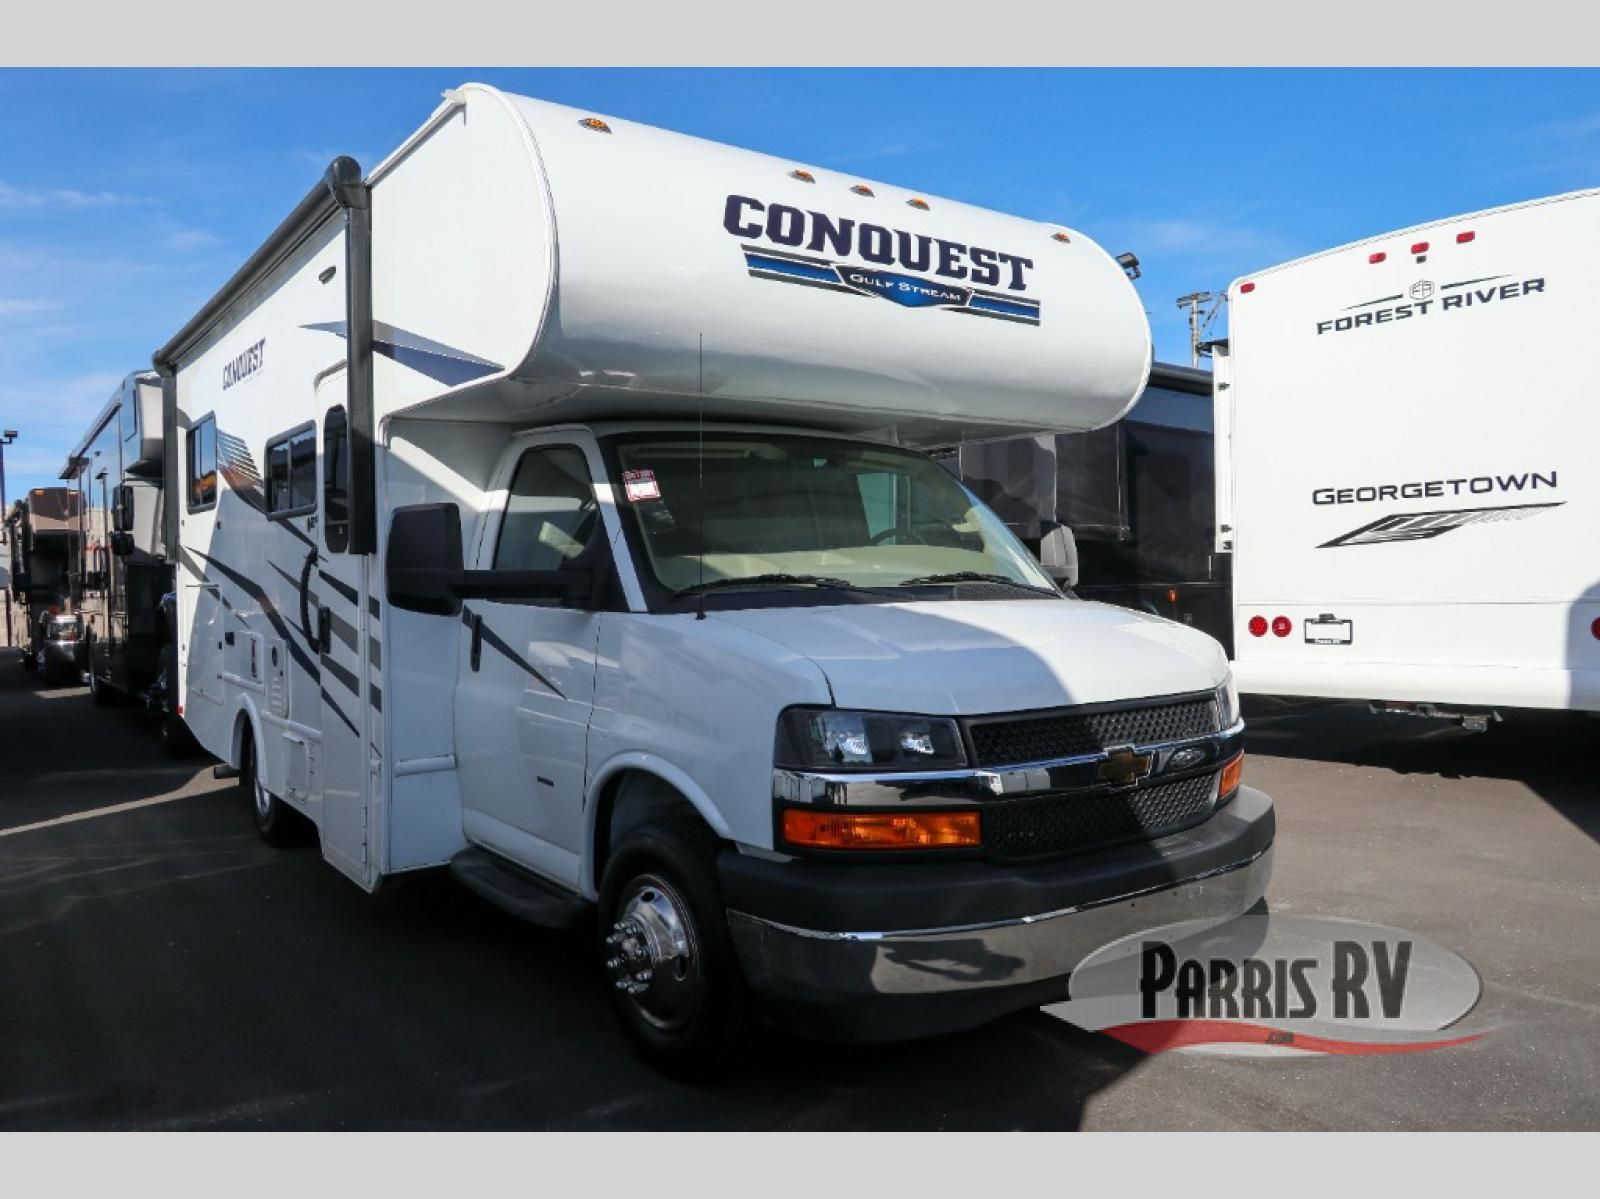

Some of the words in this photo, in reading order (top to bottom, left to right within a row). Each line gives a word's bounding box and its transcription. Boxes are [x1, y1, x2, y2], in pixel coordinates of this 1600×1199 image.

[723, 194, 1033, 290] CONQUEST
[850, 274, 894, 288] GULF
[899, 282, 961, 301] STREAM
[1317, 300, 1434, 335] FOREST
[1441, 278, 1545, 311] RIVER
[223, 337, 266, 390] CONQUEST
[1312, 471, 1557, 505] GEORGETOWN
